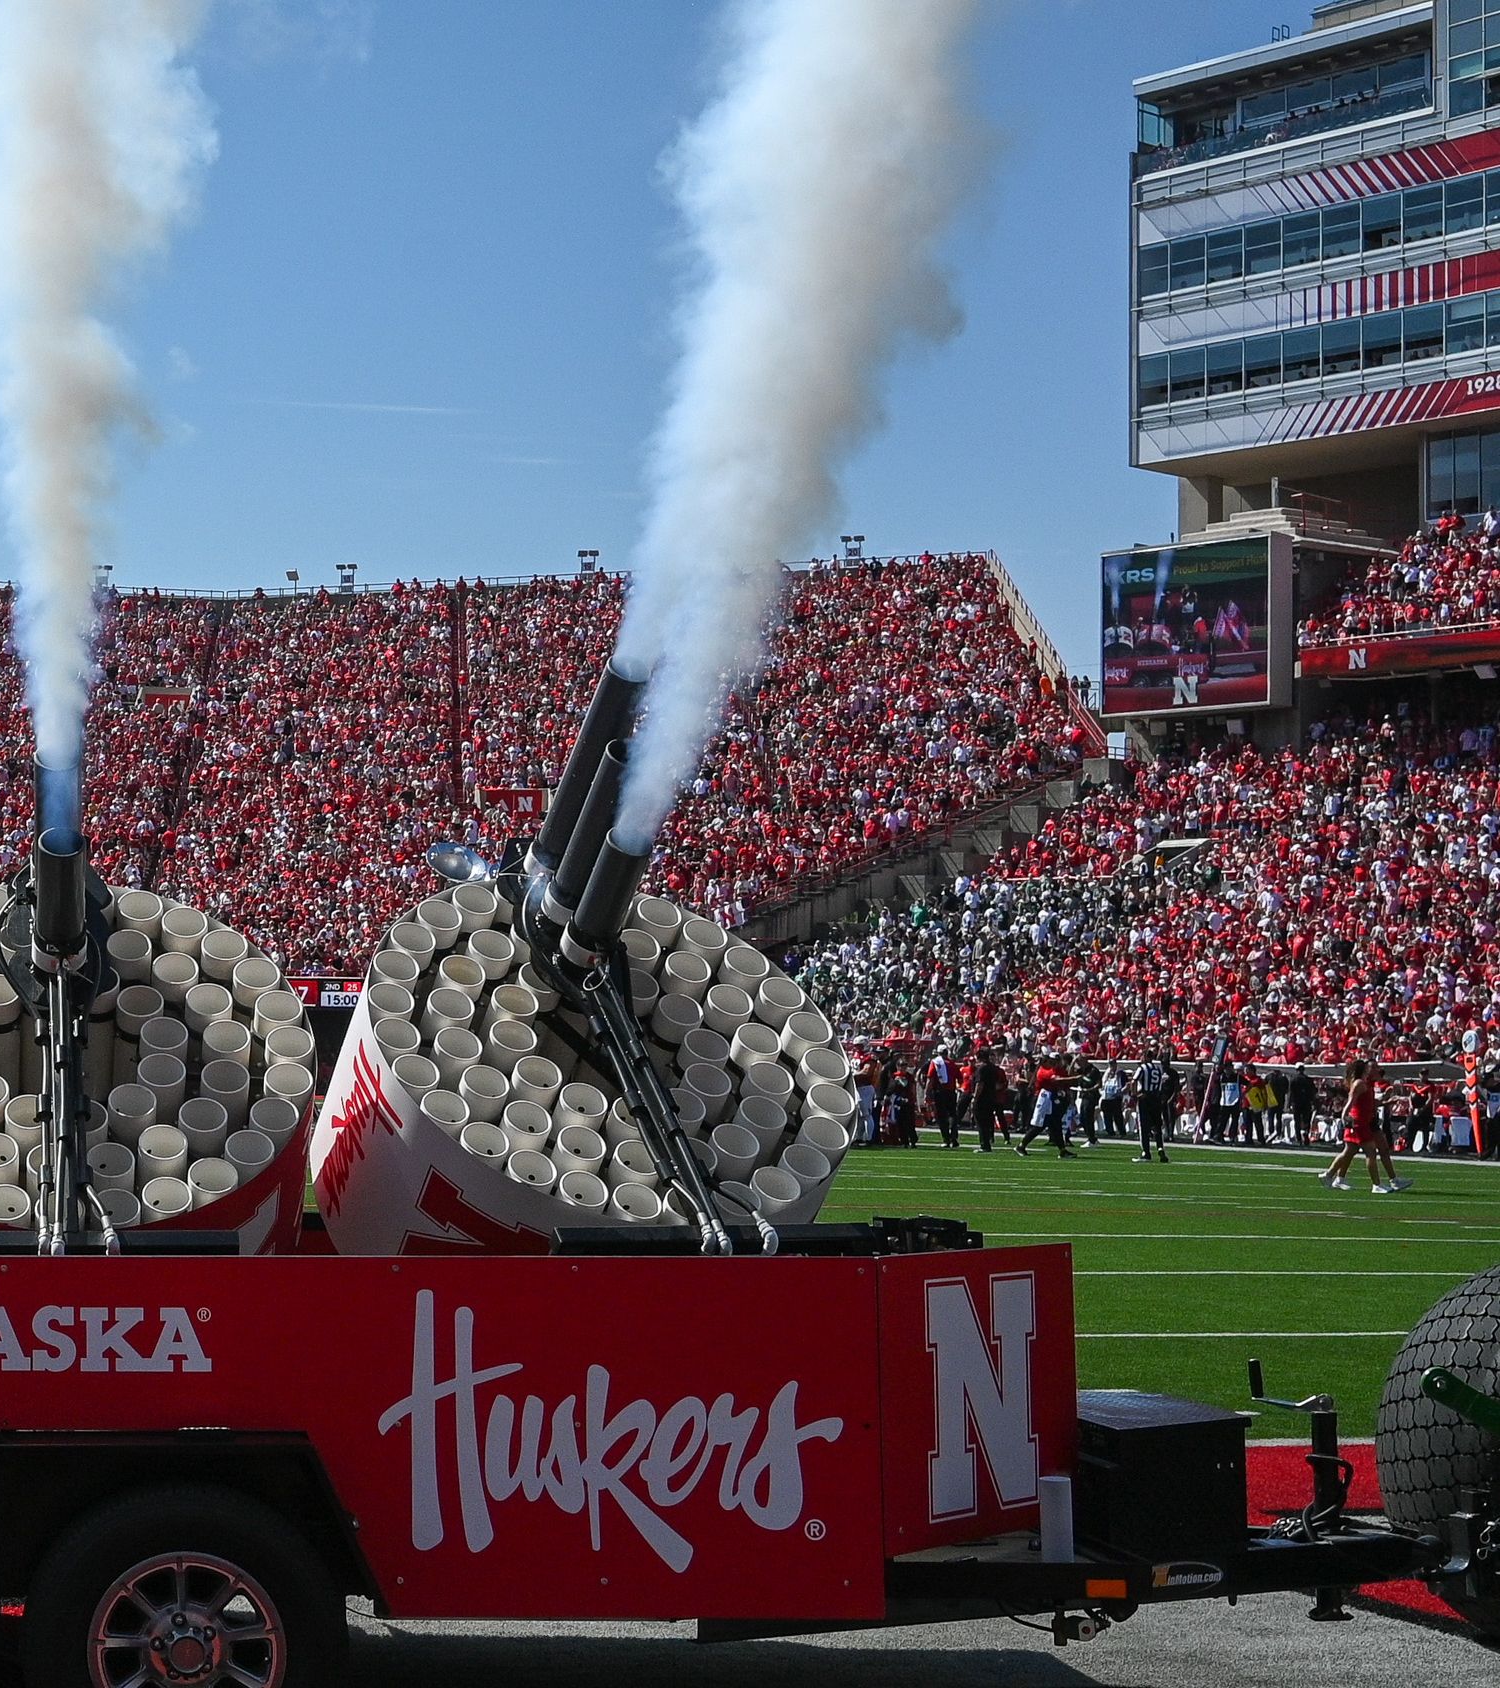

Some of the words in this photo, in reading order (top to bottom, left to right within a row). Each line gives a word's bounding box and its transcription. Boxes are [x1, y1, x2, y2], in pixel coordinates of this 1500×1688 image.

[1348, 648, 1367, 670] N
[1172, 675, 1199, 705] N
[517, 796, 533, 812] N
[296, 986, 308, 1002] 7
[325, 983, 340, 991] 2ND
[347, 983, 358, 992] 25
[327, 994, 359, 1006] 15:00
[924, 1271, 1039, 1524] N
[378, 1289, 843, 1574] Huskers
